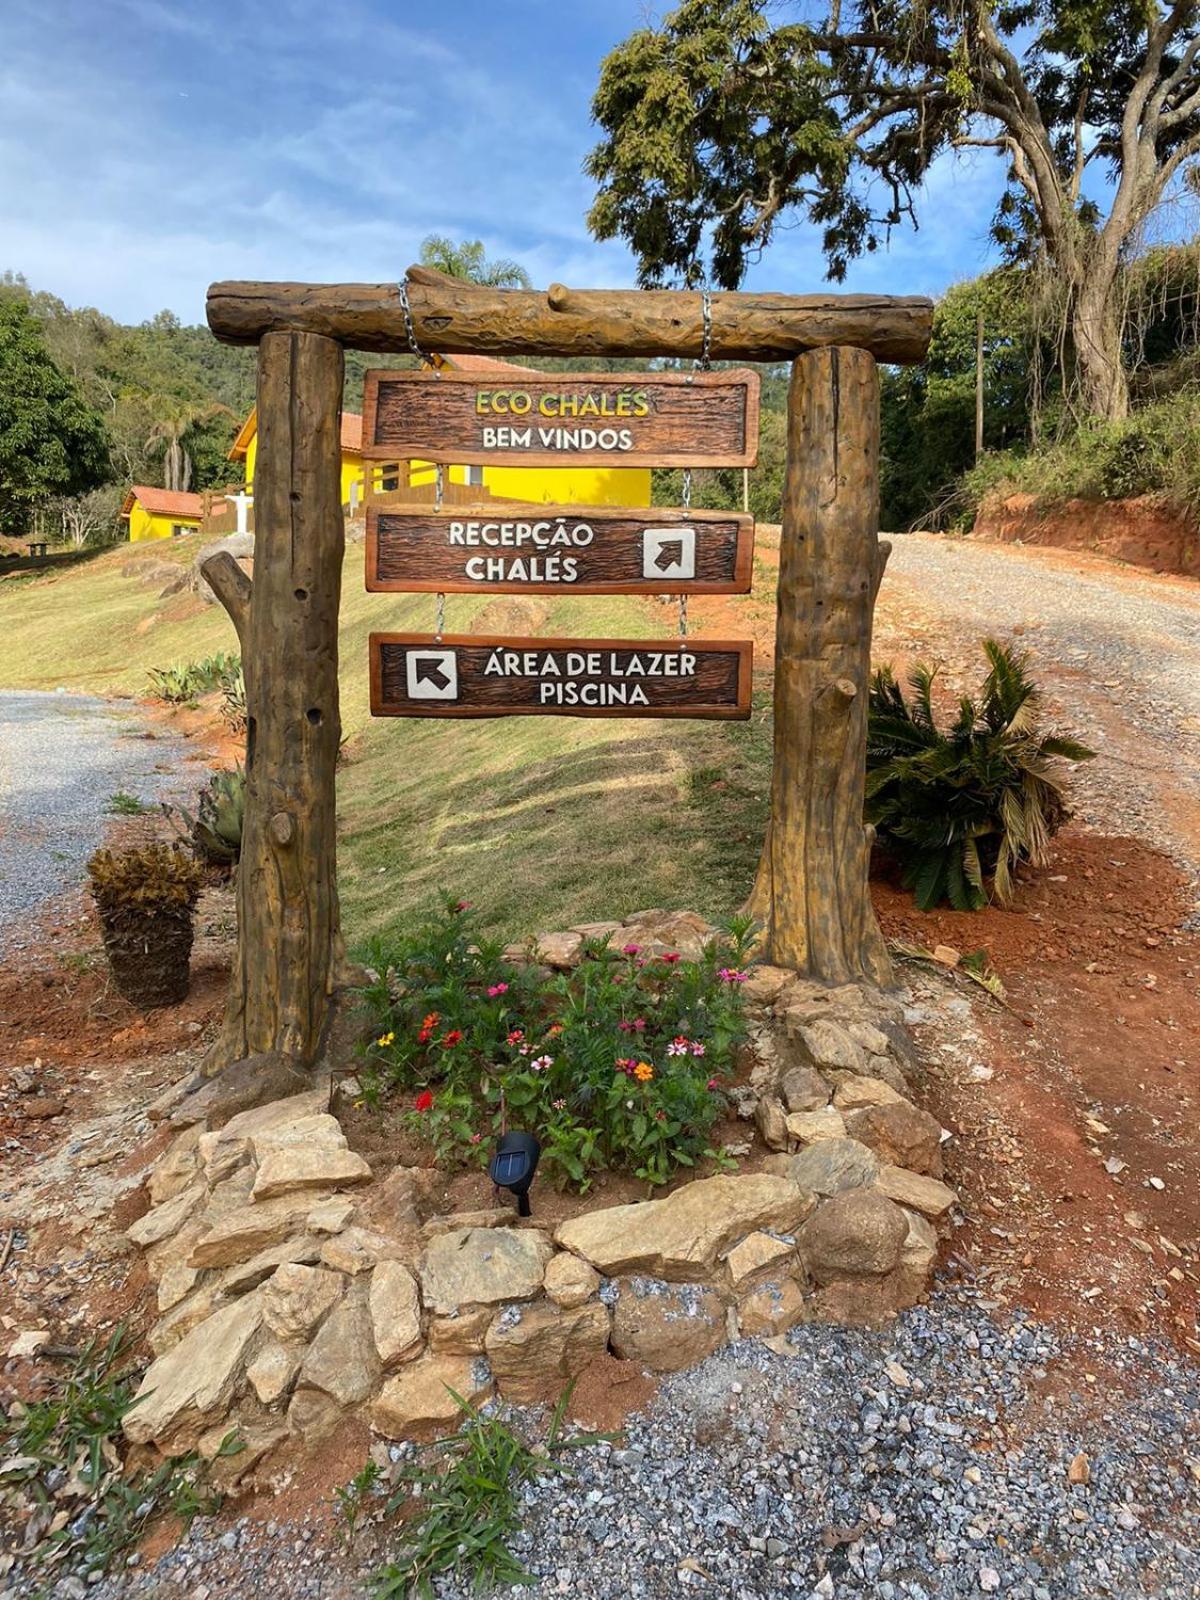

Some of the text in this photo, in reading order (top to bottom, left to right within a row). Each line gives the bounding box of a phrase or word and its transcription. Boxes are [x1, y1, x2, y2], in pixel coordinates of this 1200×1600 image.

[475, 387, 650, 417] ECO CHALÉS
[483, 427, 633, 451] BEM VINDOS
[449, 518, 594, 550] RECEPÇÃO
[466, 551, 578, 582] CHALÉS
[484, 646, 696, 676] ÁREA DE LAZER
[540, 682, 650, 706] PISCINA
